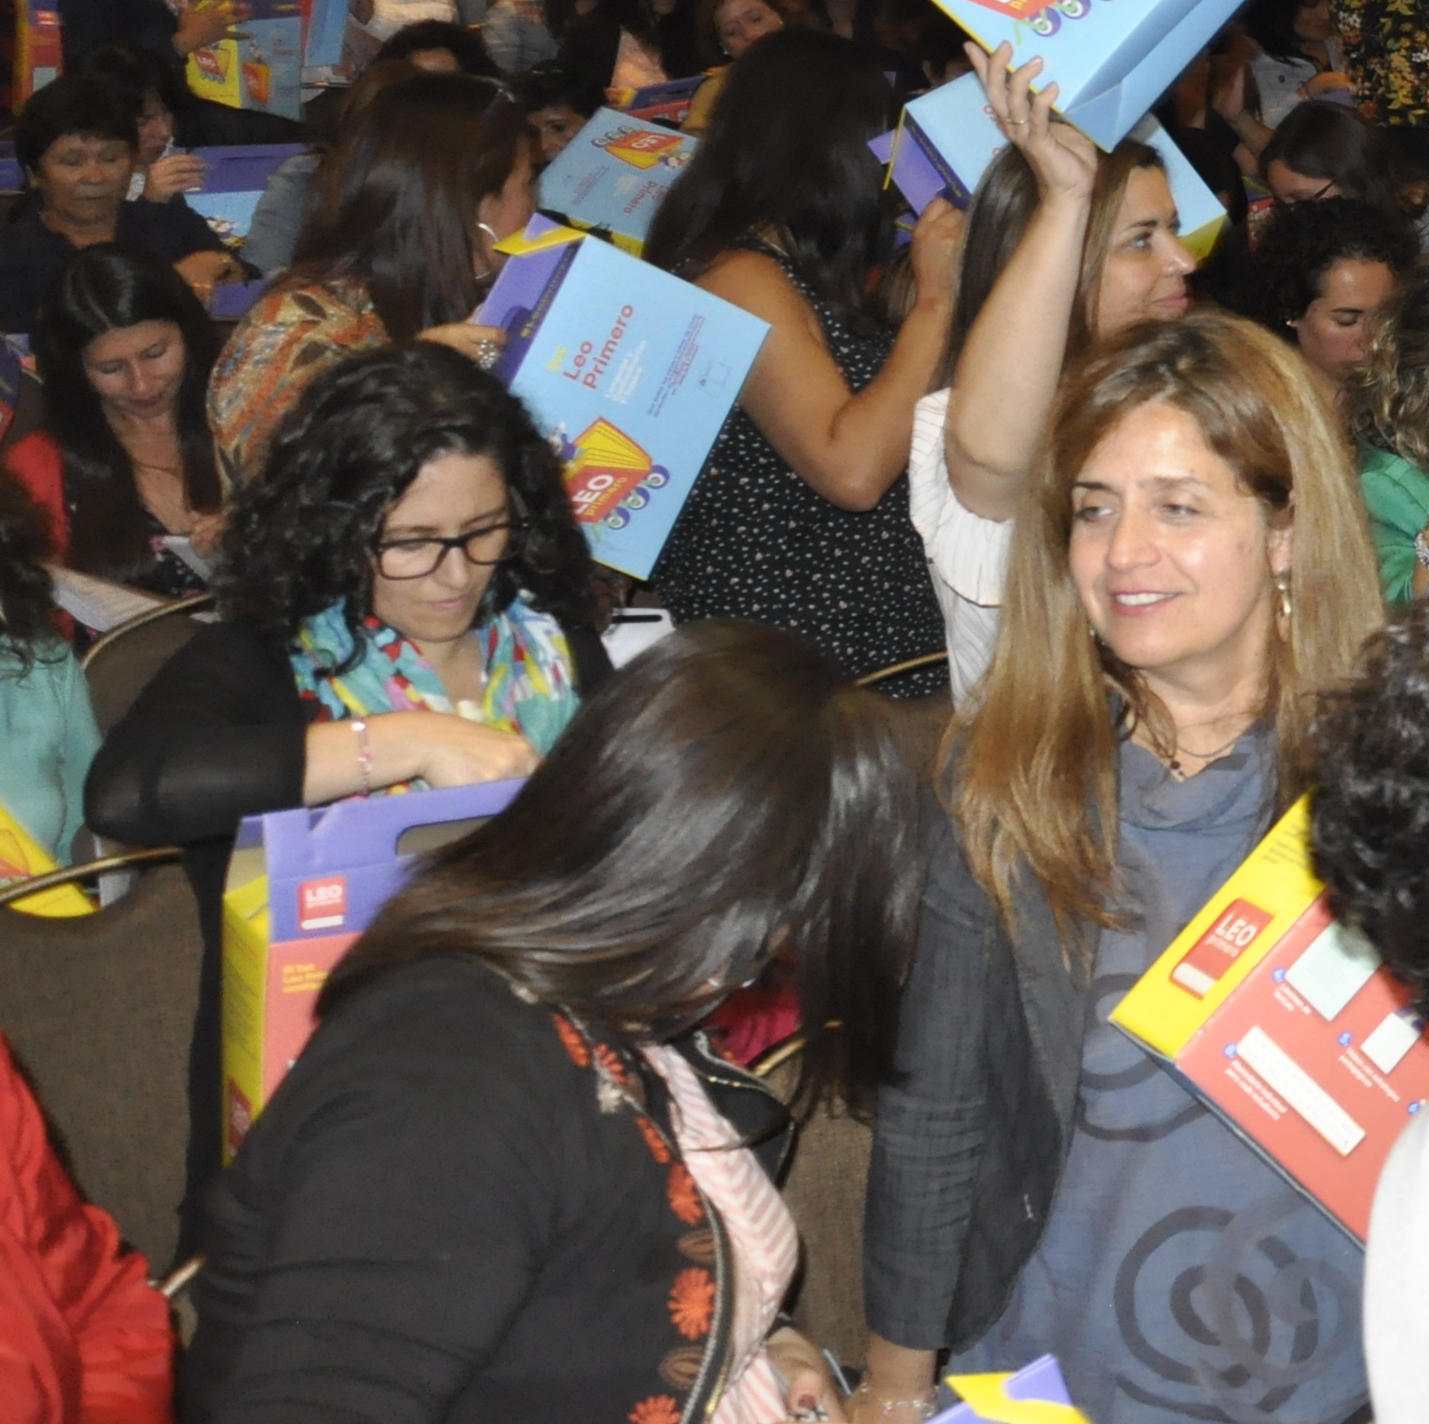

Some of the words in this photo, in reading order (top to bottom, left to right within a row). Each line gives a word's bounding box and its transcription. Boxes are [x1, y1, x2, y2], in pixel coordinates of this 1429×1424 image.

[632, 134, 665, 148] LEO
[563, 341, 593, 380] Leo
[582, 305, 634, 390] Primero
[584, 477, 628, 516] primero
[306, 885, 342, 903] LEO
[1216, 912, 1257, 947] LEO
